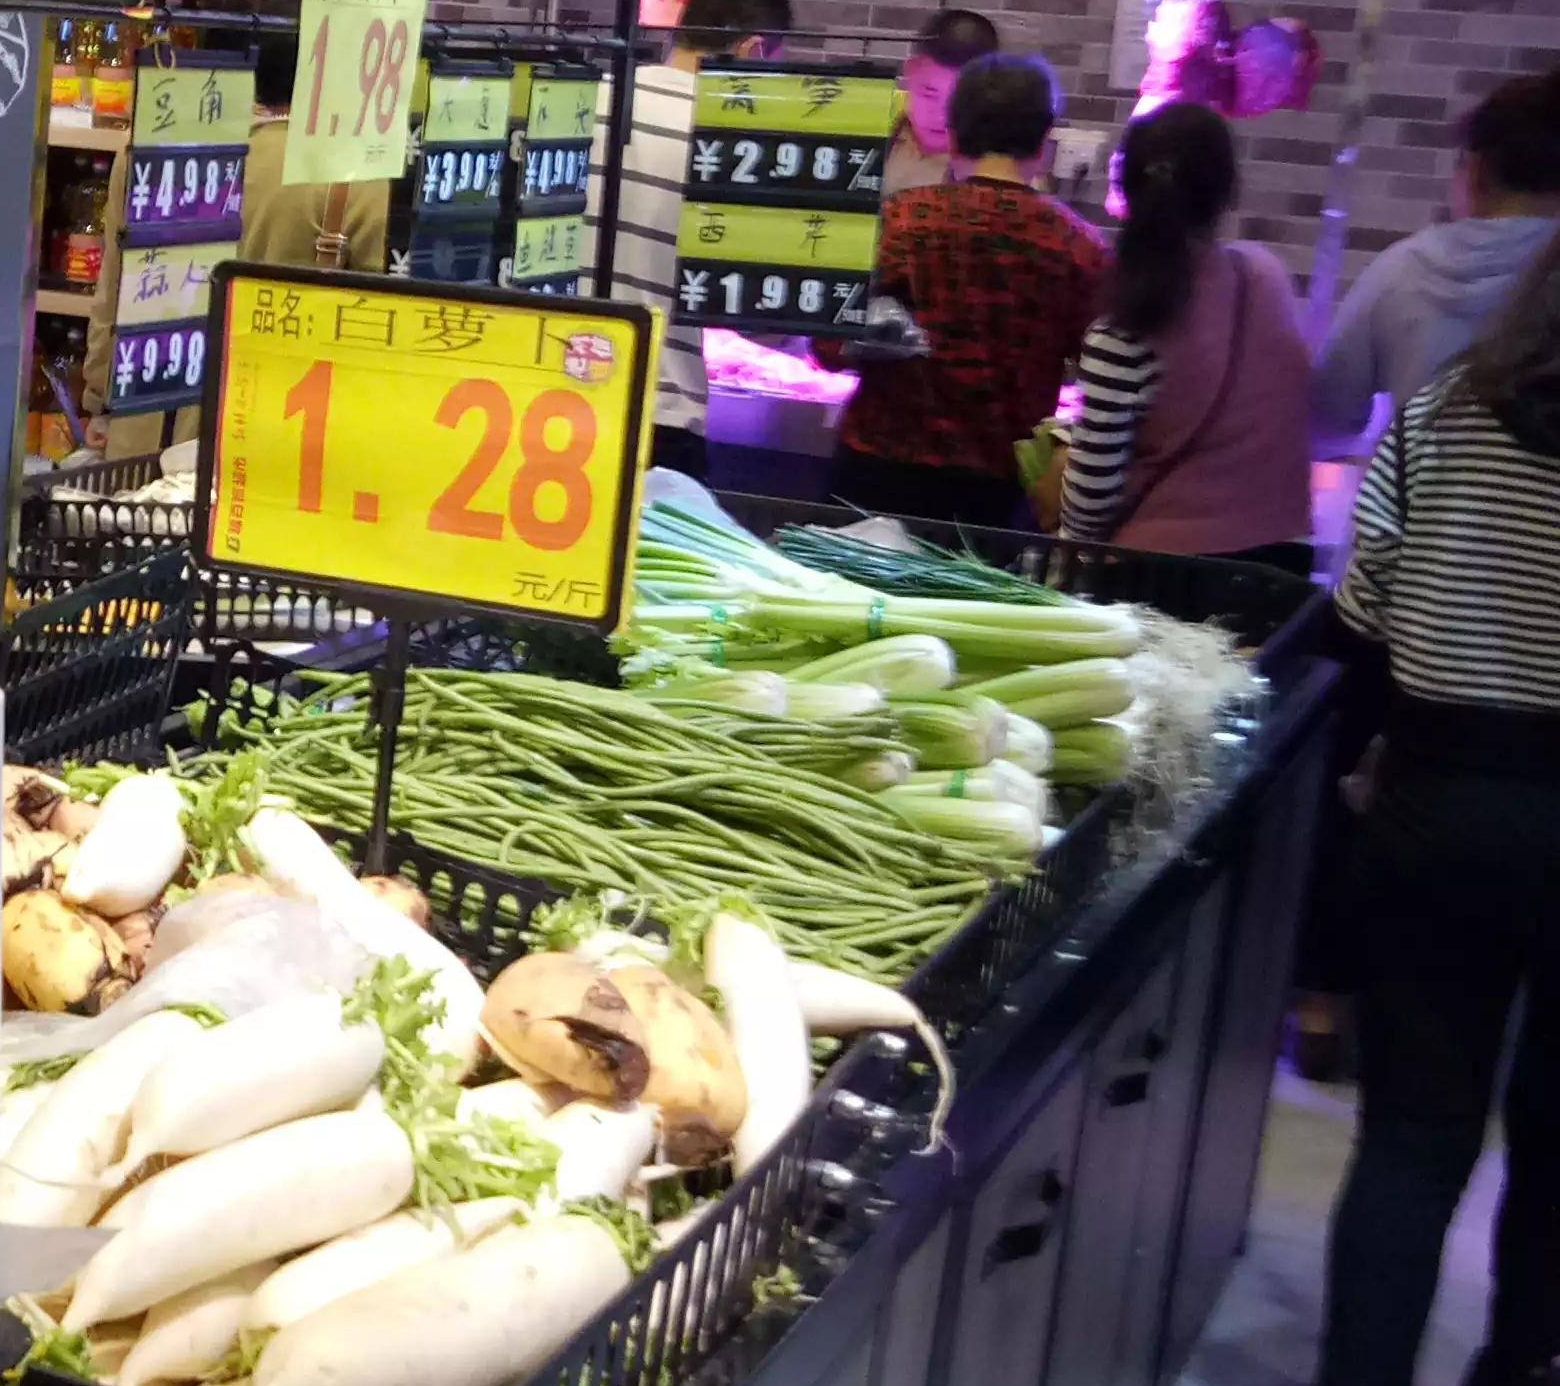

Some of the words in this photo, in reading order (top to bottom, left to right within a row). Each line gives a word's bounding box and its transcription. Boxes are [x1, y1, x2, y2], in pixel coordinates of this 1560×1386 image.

[305, 13, 409, 137] 1.98
[698, 212, 830, 259] 西芹
[334, 297, 574, 365] 白萝卜
[283, 358, 598, 553] 1.28
[512, 570, 603, 610] 元/斤
